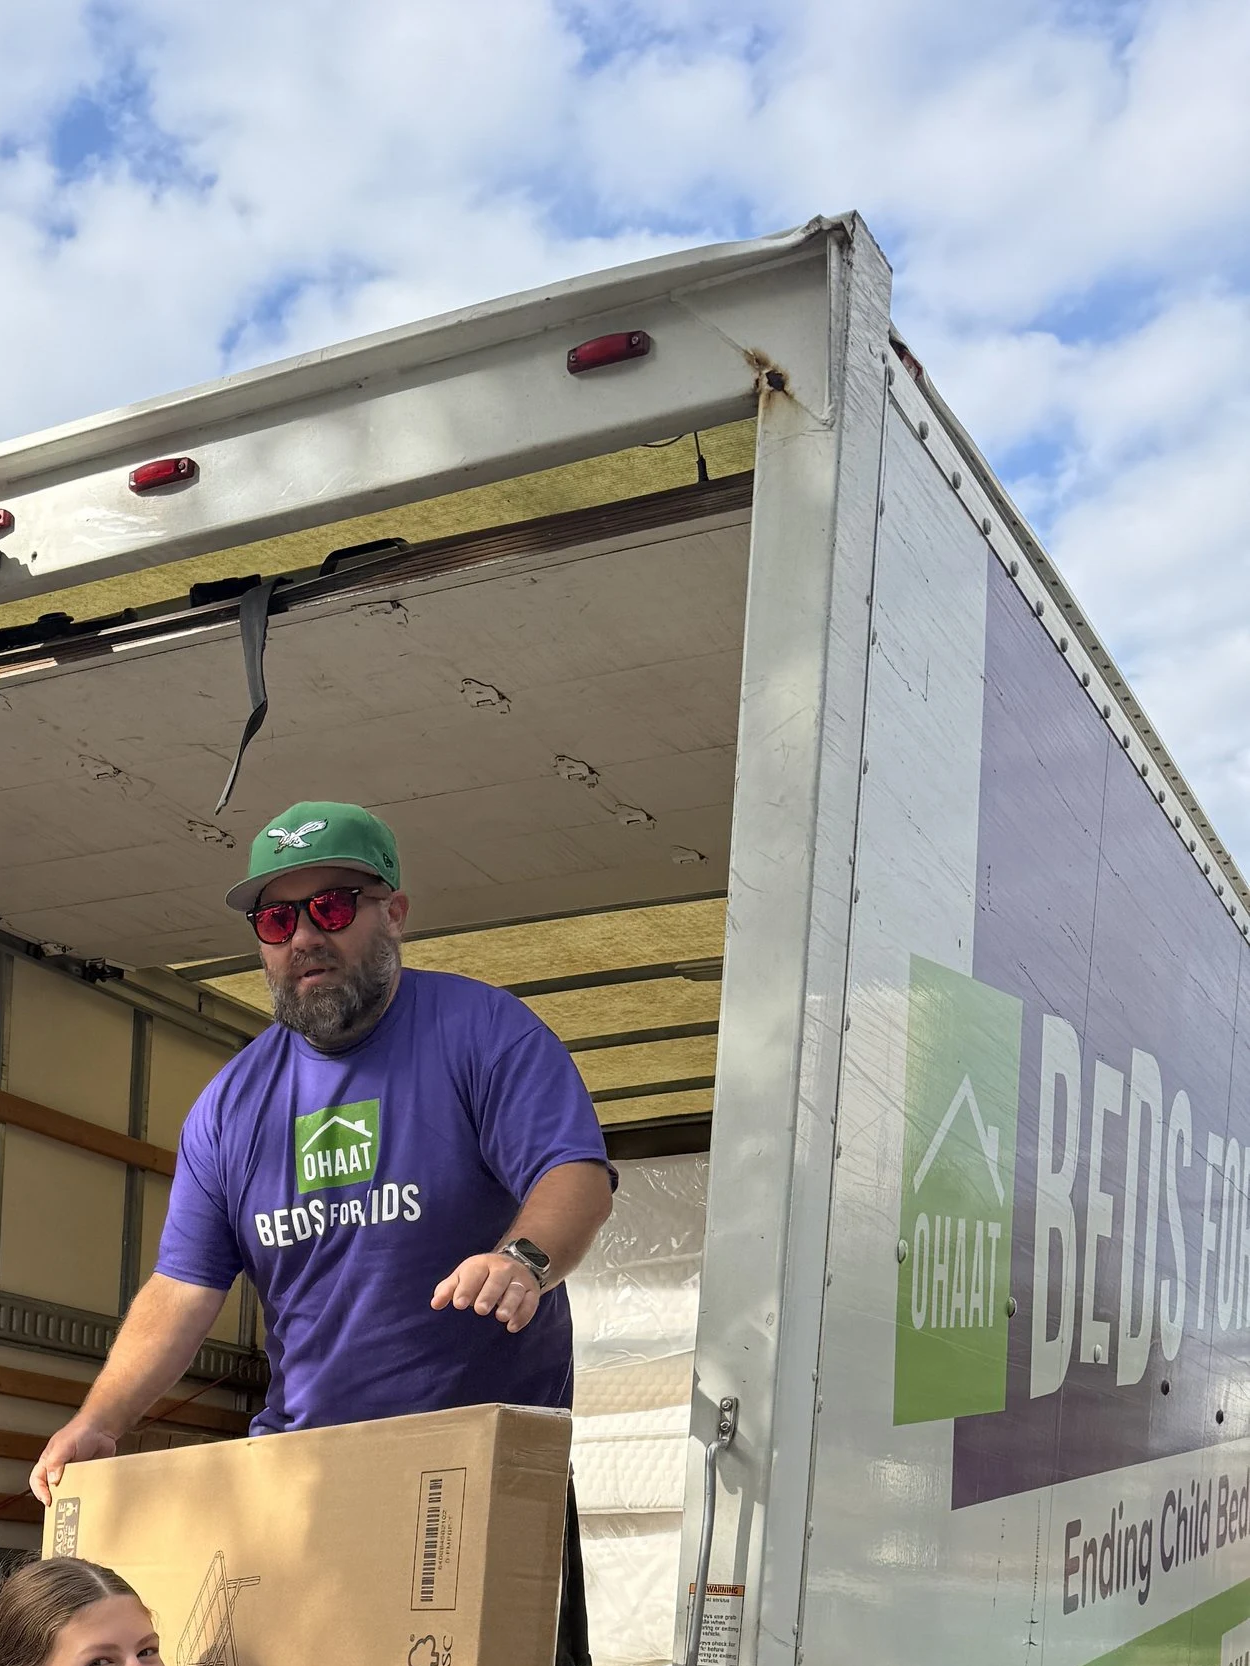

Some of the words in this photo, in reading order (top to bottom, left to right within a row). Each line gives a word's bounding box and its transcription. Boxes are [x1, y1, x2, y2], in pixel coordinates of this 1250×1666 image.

[302, 1141, 372, 1181] OHAAT
[254, 1198, 325, 1248] BEDS
[329, 1199, 363, 1227] FOR
[363, 1182, 422, 1227] IDS
[1029, 1012, 1192, 1400] BEDS
[909, 1212, 1003, 1332] OHAAT
[55, 1502, 67, 1554] AGILE
[66, 1524, 77, 1557] ARE
[1062, 1499, 1153, 1616] Ending
[1159, 1478, 1212, 1573] Child
[1216, 1466, 1250, 1549] Bed
[706, 1585, 739, 1595] WARNING
